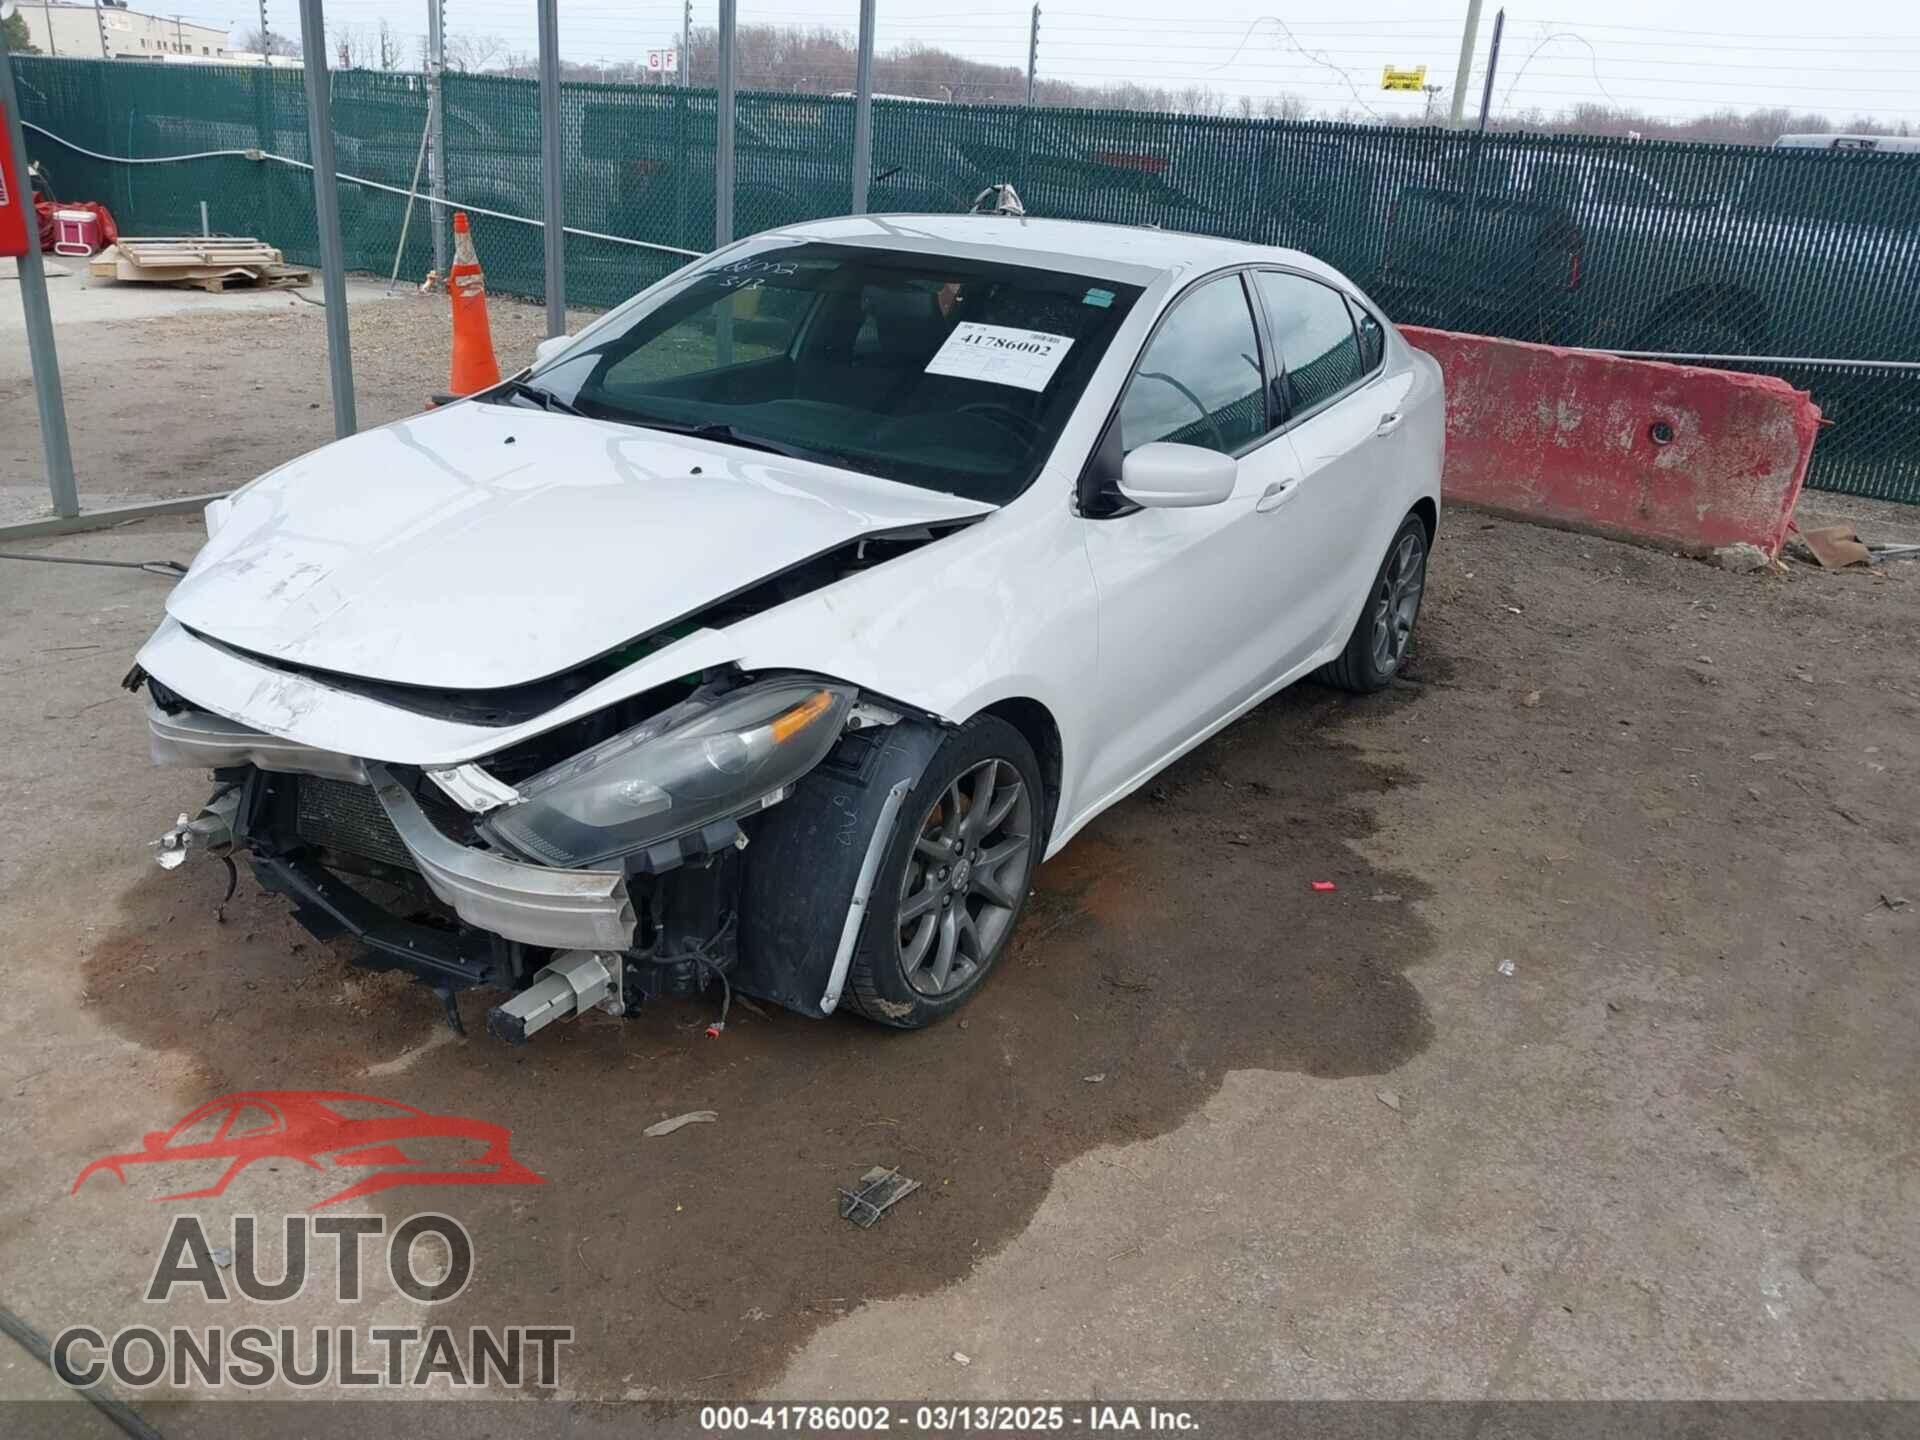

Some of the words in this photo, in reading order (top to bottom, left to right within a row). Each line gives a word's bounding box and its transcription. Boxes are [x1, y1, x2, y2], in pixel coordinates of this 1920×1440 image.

[650, 53, 659, 68] G
[666, 53, 673, 68] F
[960, 333, 1053, 357] 41786002
